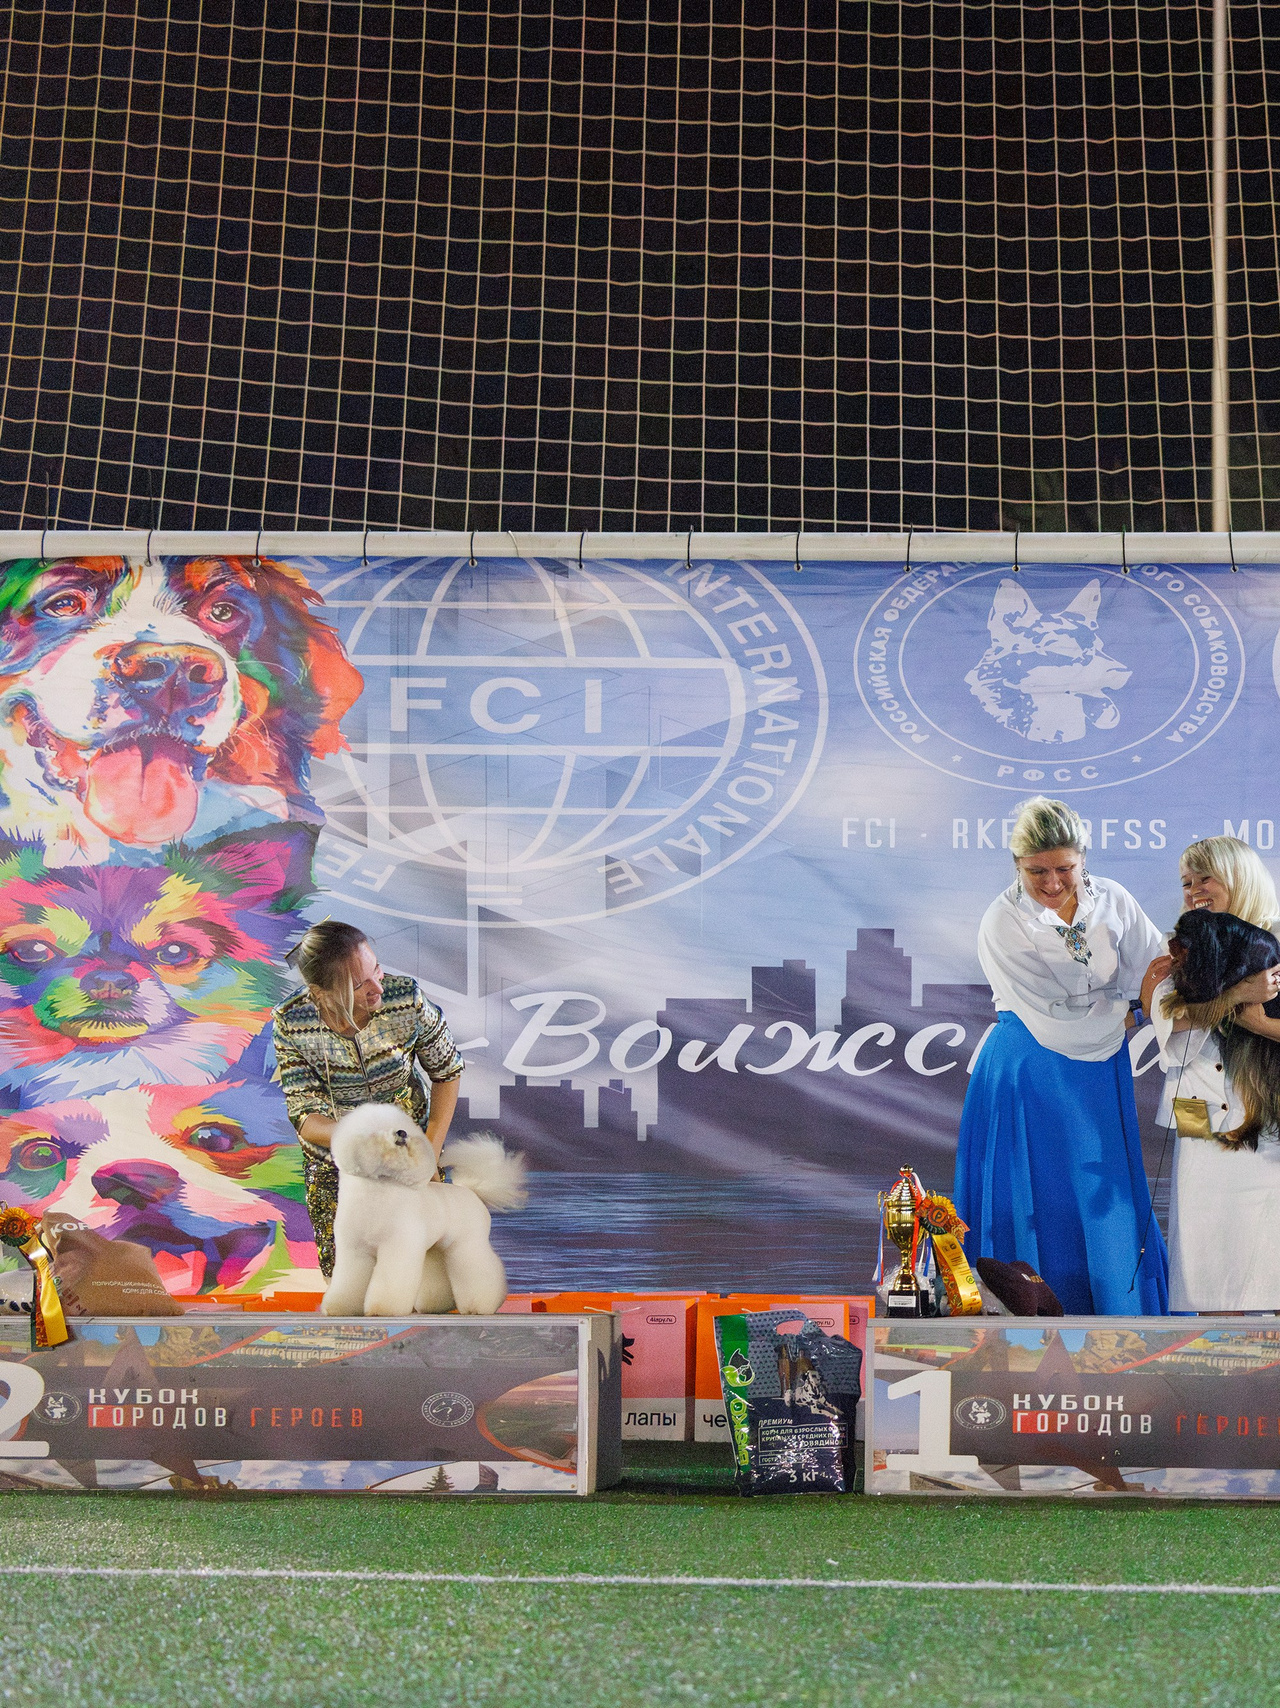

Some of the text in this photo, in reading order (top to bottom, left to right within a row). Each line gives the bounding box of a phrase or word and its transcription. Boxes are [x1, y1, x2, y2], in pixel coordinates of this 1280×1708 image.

[868, 626, 930, 744] РОССИЙСКАЯ
[1166, 594, 1229, 744] СОБАКОВОДСТВА
[390, 677, 602, 734] FCI
[996, 764, 1099, 783] РФСС
[842, 818, 896, 849] FCI
[88, 1388, 199, 1405] КУБОК
[1013, 1394, 1124, 1411] КУБОК
[88, 1408, 228, 1429] ГОРОДОВ
[250, 1408, 363, 1428] ГЕРОЕВ
[624, 1412, 676, 1426] лапы
[758, 1419, 793, 1427] ПРЕМИУМ
[887, 1370, 979, 1472] 1
[1013, 1411, 1152, 1435] ГОРОДОВ
[789, 1471, 798, 1483] 3
